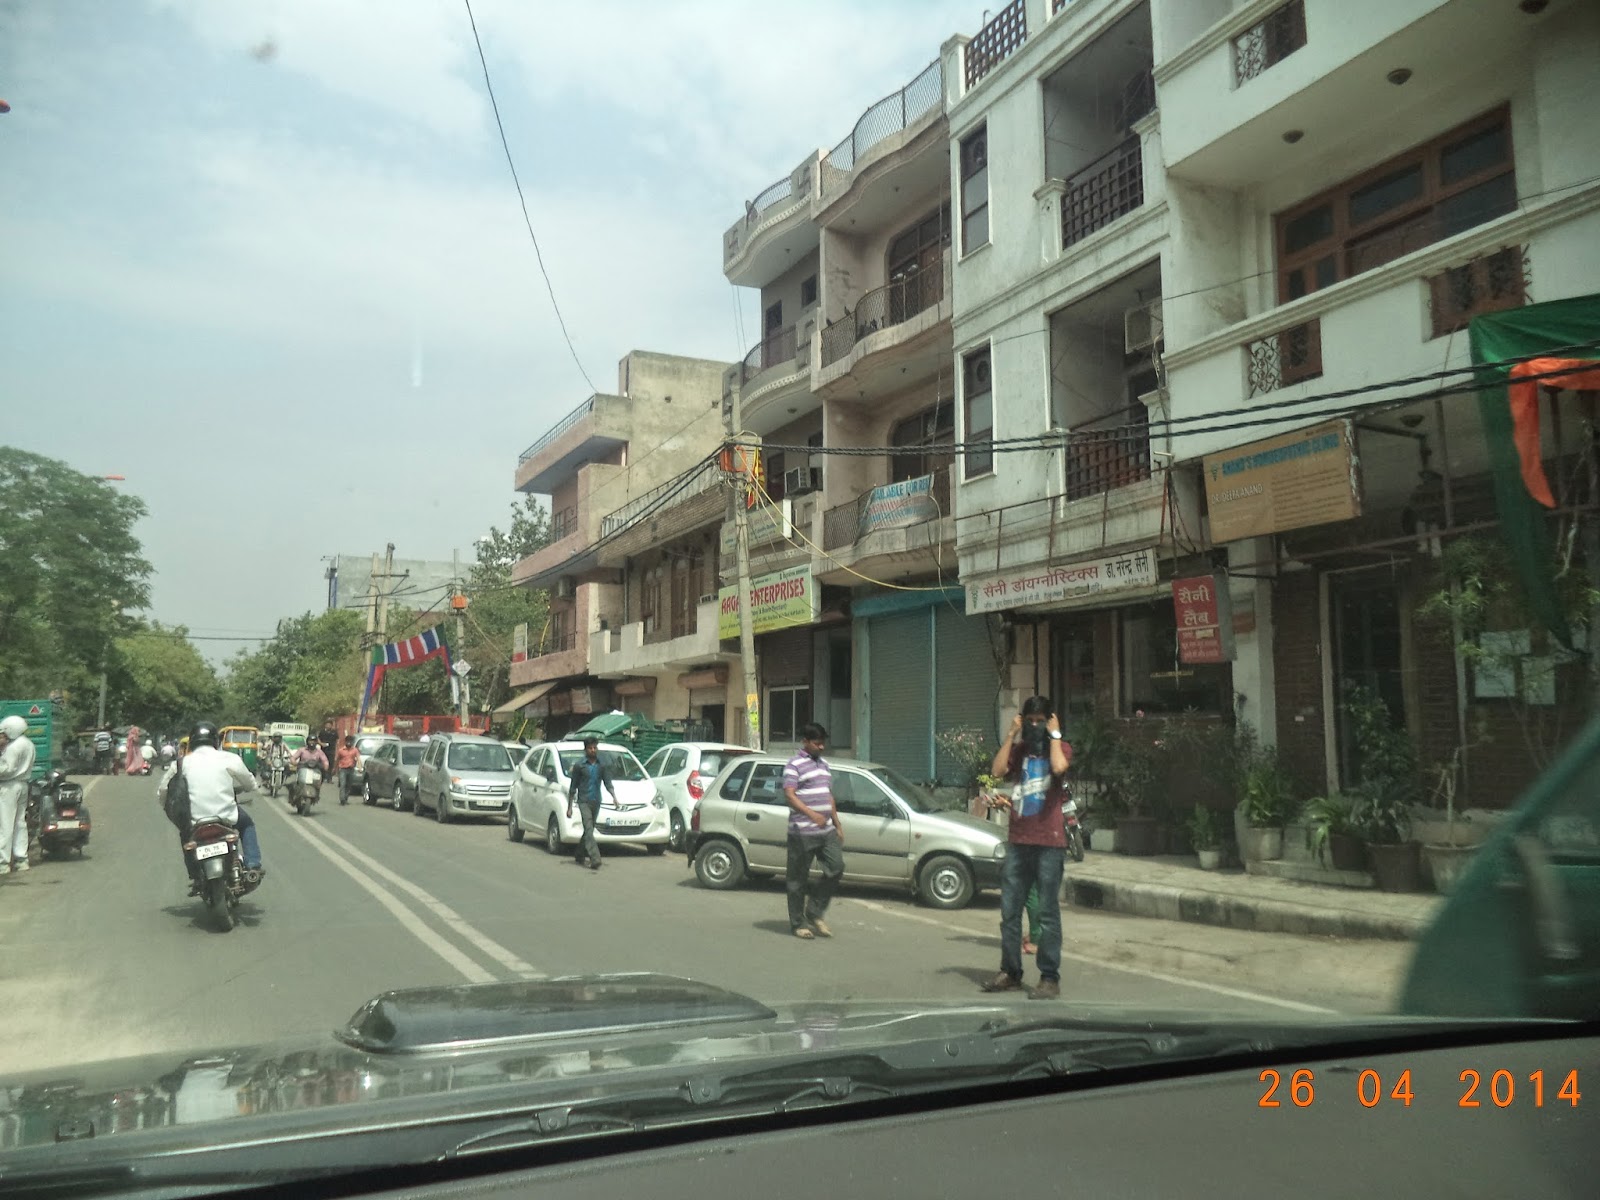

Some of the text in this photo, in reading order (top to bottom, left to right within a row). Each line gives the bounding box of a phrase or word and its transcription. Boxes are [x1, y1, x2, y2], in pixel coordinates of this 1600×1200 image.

[750, 577, 805, 608] ENTERPRISES
[983, 578, 1007, 599] सैनी
[1178, 584, 1210, 604] सैनी
